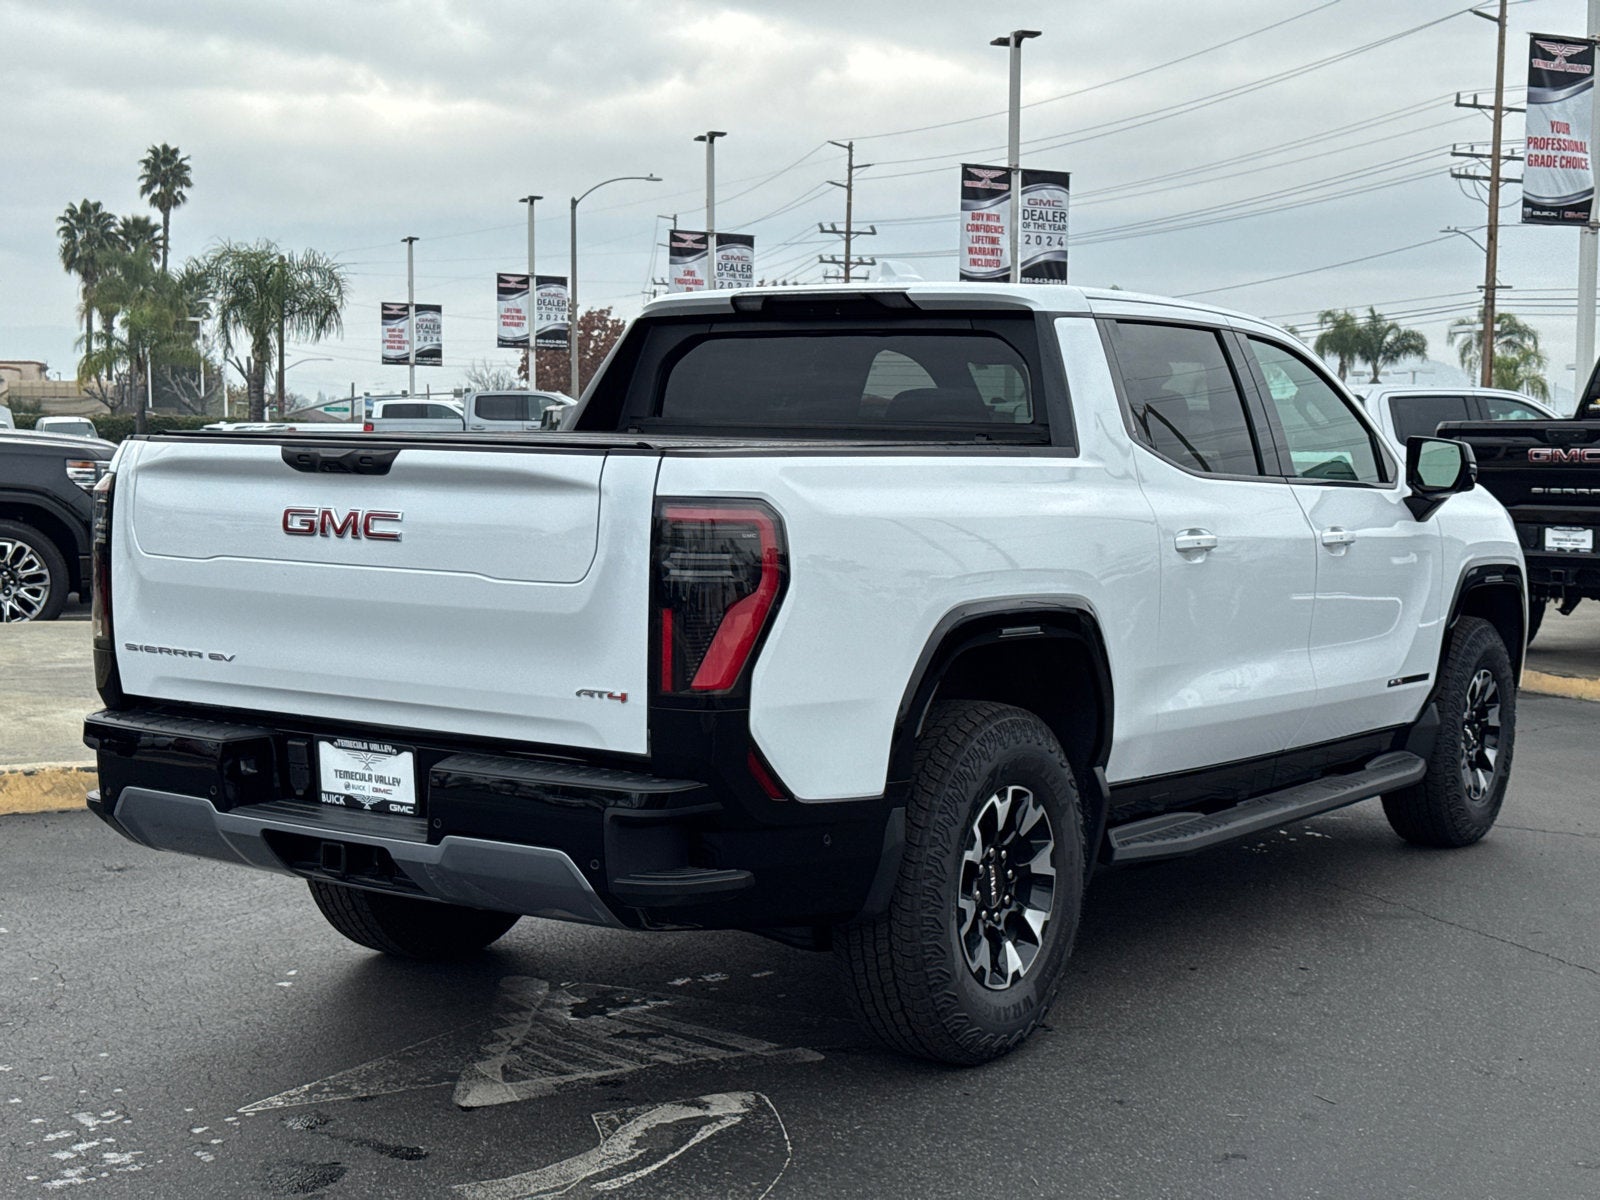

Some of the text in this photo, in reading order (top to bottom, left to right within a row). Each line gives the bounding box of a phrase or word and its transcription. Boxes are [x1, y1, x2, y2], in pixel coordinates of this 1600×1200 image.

[1550, 120, 1570, 135] YOUR
[1527, 136, 1588, 154] PROFESSIONAL
[1528, 154, 1590, 170] GRADE CHOICE
[1027, 198, 1062, 208] GMC
[972, 212, 1000, 223] BUY WITH
[1022, 208, 1067, 223] DEALER
[1564, 211, 1589, 219] GMC
[966, 224, 1005, 234] CONFIDENCE
[1033, 222, 1046, 230] THE
[1048, 224, 1066, 232] YEAR
[972, 235, 1000, 246] LIFETIME
[1024, 234, 1064, 247] 2024
[968, 246, 1003, 256] WARRANTY
[717, 262, 752, 273] DEALER
[970, 258, 1001, 268] INCLUDED
[536, 298, 566, 306] DEALER
[1528, 448, 1600, 463] GMC
[282, 506, 404, 542] GMC
[124, 642, 236, 662] SIERRA EV
[576, 688, 628, 704] AT4
[337, 738, 392, 754] TEMECULA VALLEY
[334, 769, 401, 787] TEMECULA VALLEY
[372, 787, 392, 795] GMC
[321, 793, 414, 814] BUICK GMC
